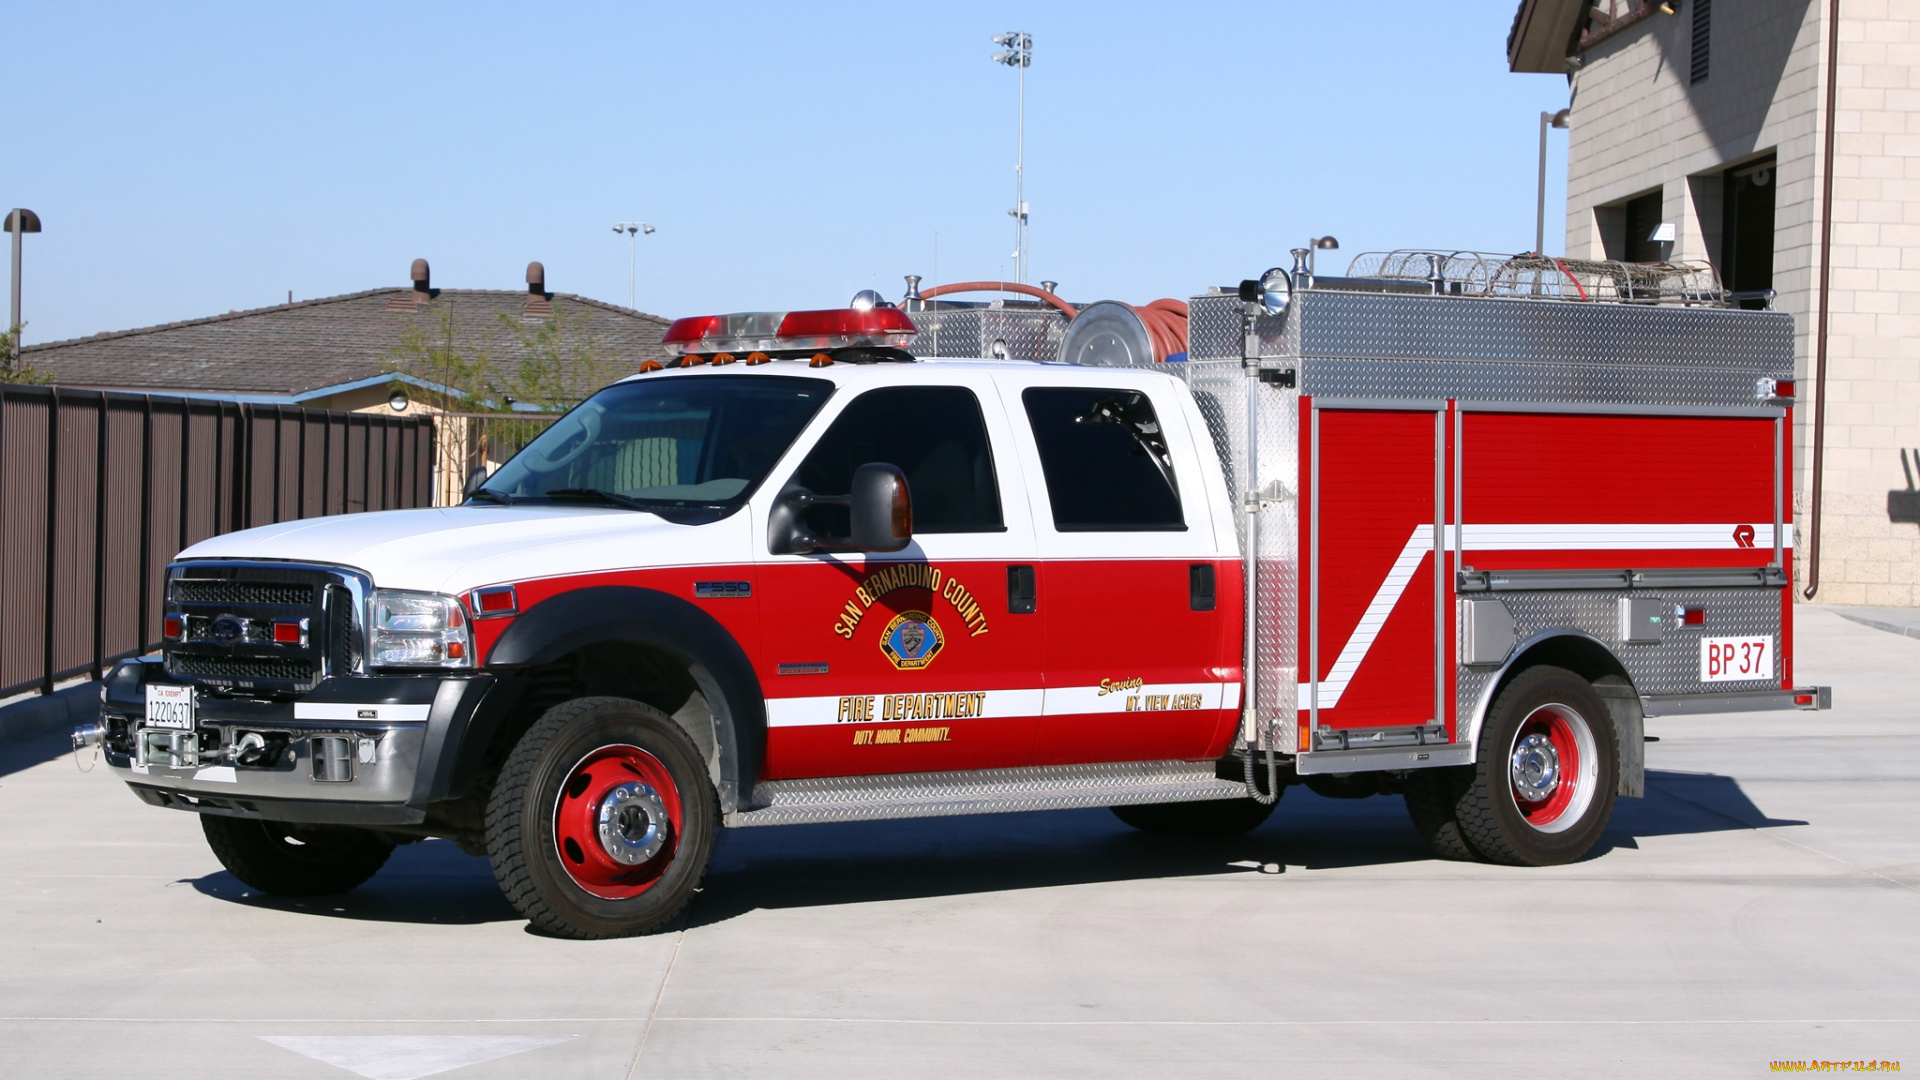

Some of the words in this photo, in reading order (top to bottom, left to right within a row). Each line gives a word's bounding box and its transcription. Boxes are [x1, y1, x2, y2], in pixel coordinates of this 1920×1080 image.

[834, 600, 863, 639] SAN
[855, 563, 942, 608] BERNARDINO
[943, 577, 989, 637] COUNTY
[881, 630, 892, 646] SAN
[926, 619, 943, 645] COUNTY
[889, 651, 901, 665] FIRE
[900, 650, 934, 667] DEPARTMENT
[1709, 643, 1735, 676] BP
[1739, 641, 1765, 674] 37
[165, 690, 182, 698] EXEMPT
[1098, 676, 1143, 697] Serving
[149, 700, 189, 724] 1220637
[838, 696, 875, 723] FIRE
[882, 692, 986, 721] DEPARTMENT
[1126, 695, 1142, 711] MT.
[1145, 694, 1170, 711] VIEW
[1171, 693, 1203, 710] ACRES
